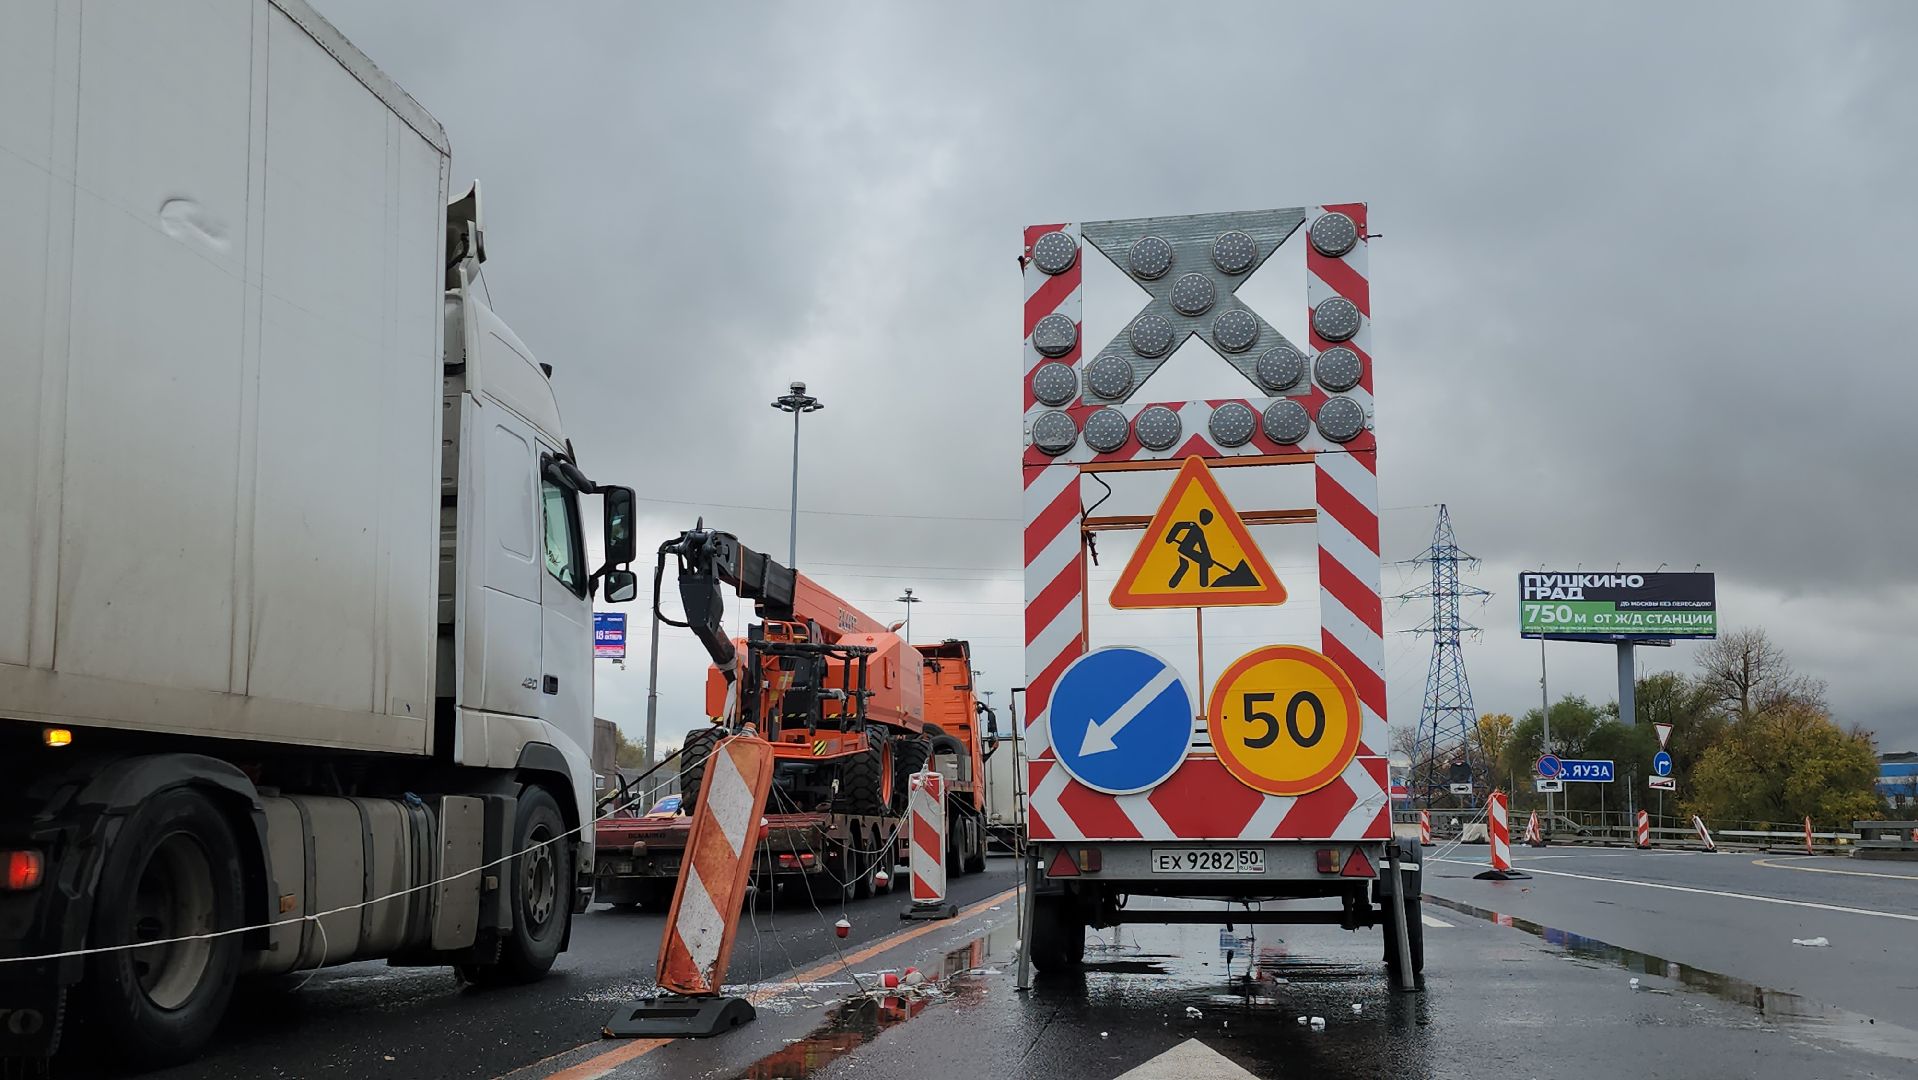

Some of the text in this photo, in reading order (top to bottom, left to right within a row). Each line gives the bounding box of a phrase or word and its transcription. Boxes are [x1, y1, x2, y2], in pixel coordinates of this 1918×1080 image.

[1524, 574, 1645, 588] ПУШКИНО
[1524, 587, 1584, 600] ГРАД
[1594, 613, 1612, 623] ОТ
[1615, 612, 1643, 625] Ж/Д
[1646, 614, 1713, 625] СТАНЦИИ
[1243, 690, 1326, 750] 50
[1572, 765, 1610, 777] ЯУЗА
[1187, 852, 1235, 870] 9282
[1239, 851, 1259, 865] 50
